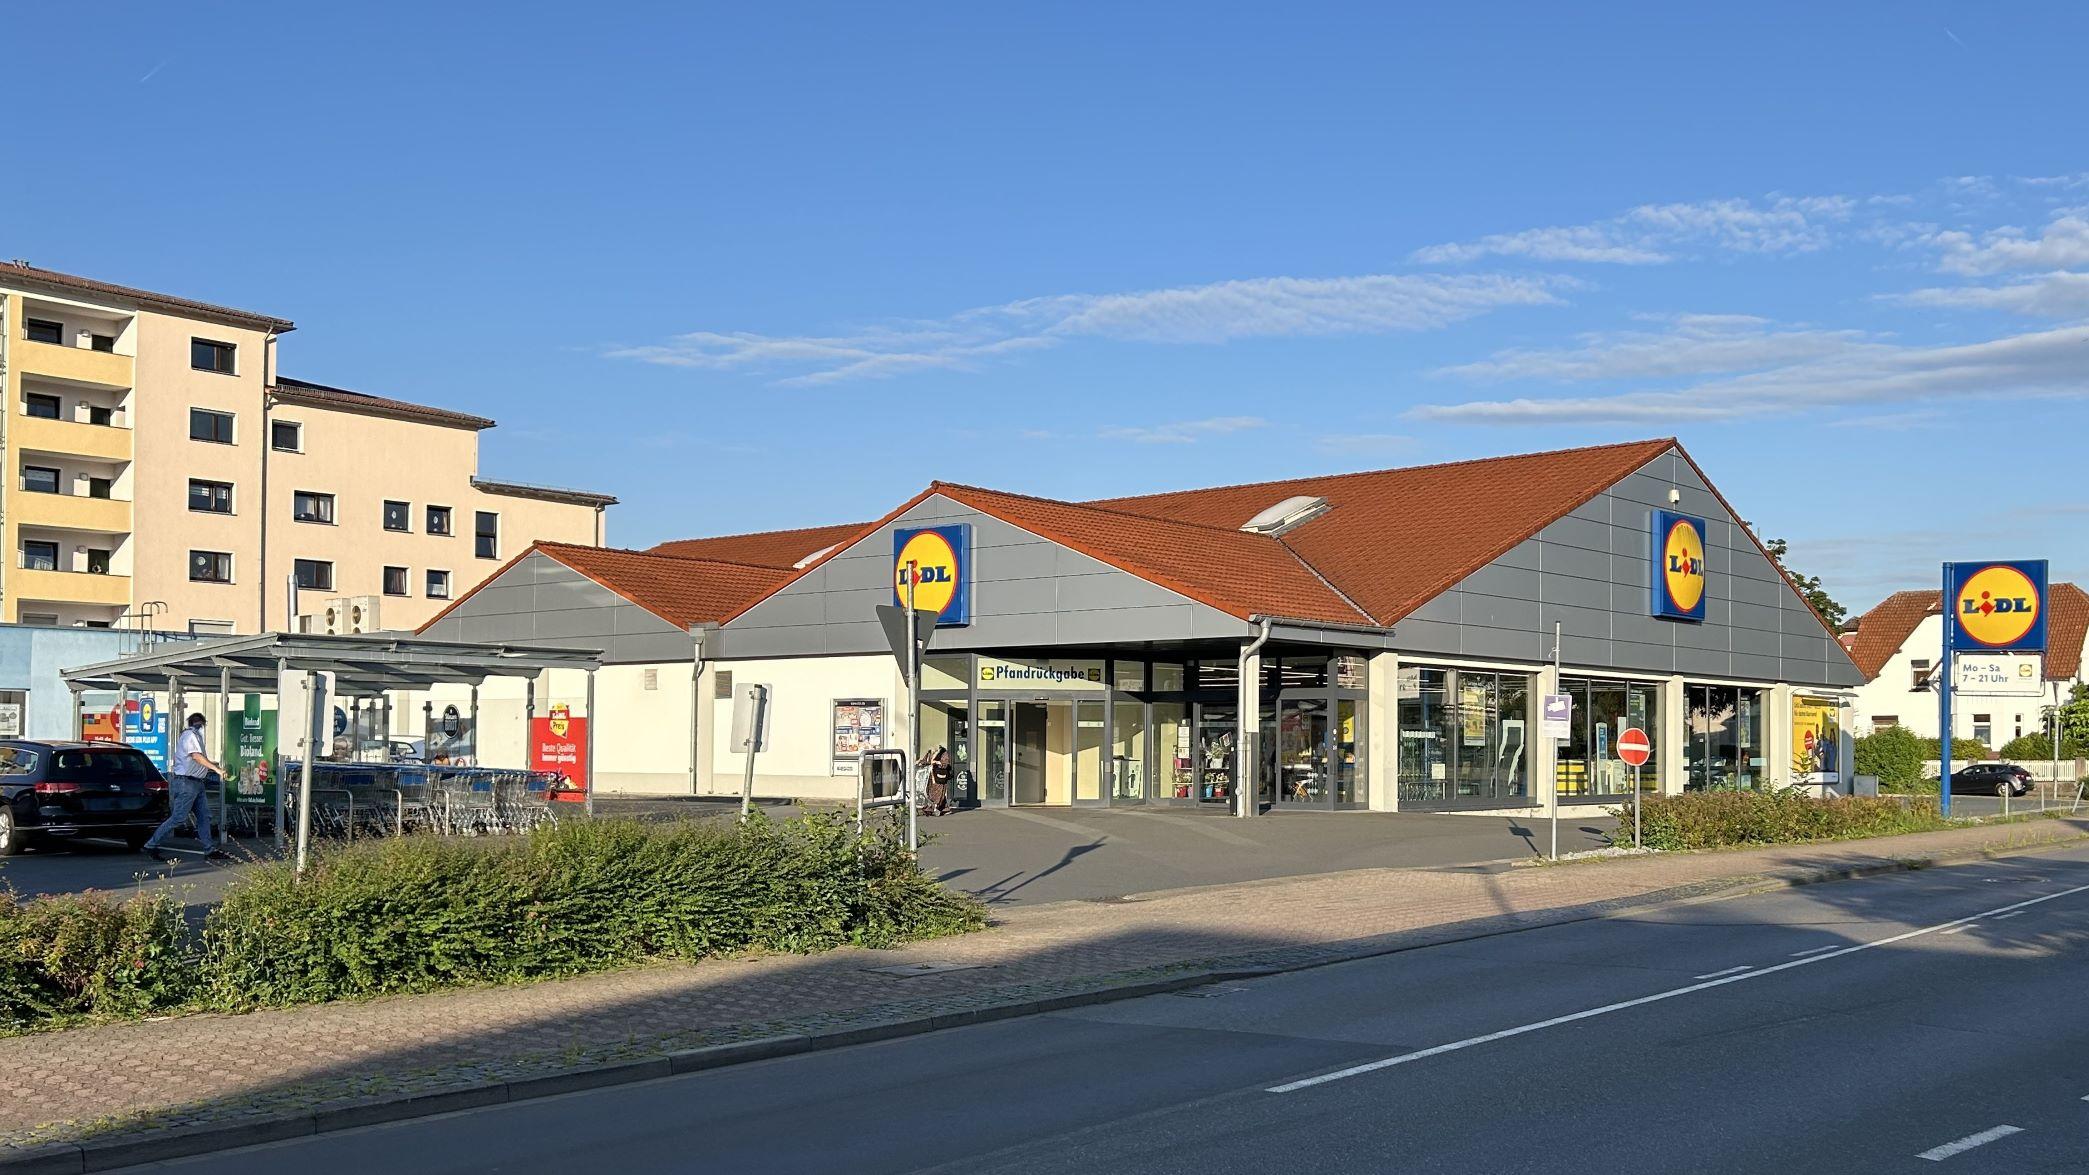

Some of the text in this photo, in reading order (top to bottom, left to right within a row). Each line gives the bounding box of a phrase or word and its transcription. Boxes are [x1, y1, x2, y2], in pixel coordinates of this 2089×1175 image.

[1963, 664, 1978, 672] Mo
[1989, 664, 2000, 672] Sa
[996, 665, 1085, 683] Pfandrückgabe
[1963, 674, 1968, 682] 7
[1991, 674, 2008, 683] Uhr
